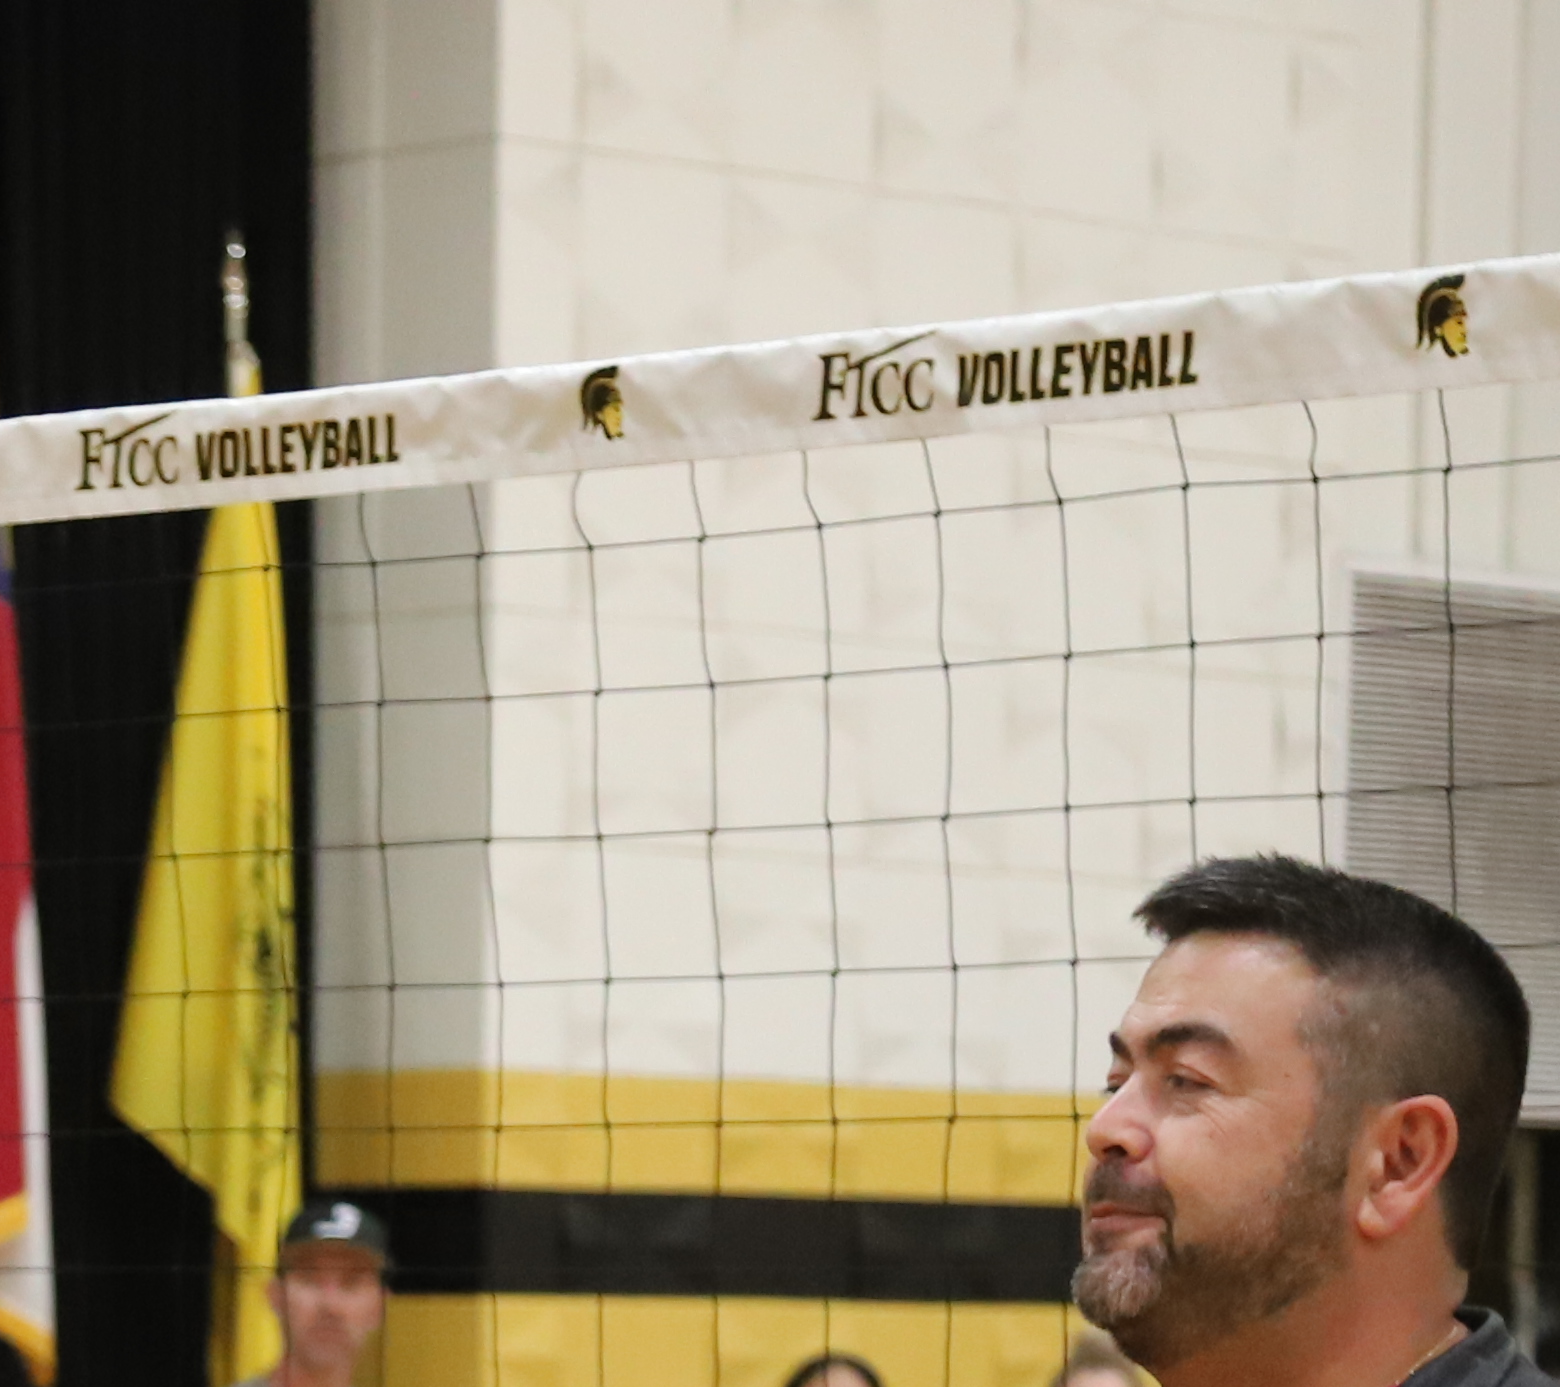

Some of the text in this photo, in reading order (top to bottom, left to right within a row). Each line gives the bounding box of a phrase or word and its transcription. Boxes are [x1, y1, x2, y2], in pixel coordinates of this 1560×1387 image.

[812, 330, 1198, 421] FTCC VOLLEYBALL
[75, 412, 400, 491] FTCC VOLLEYBALL
